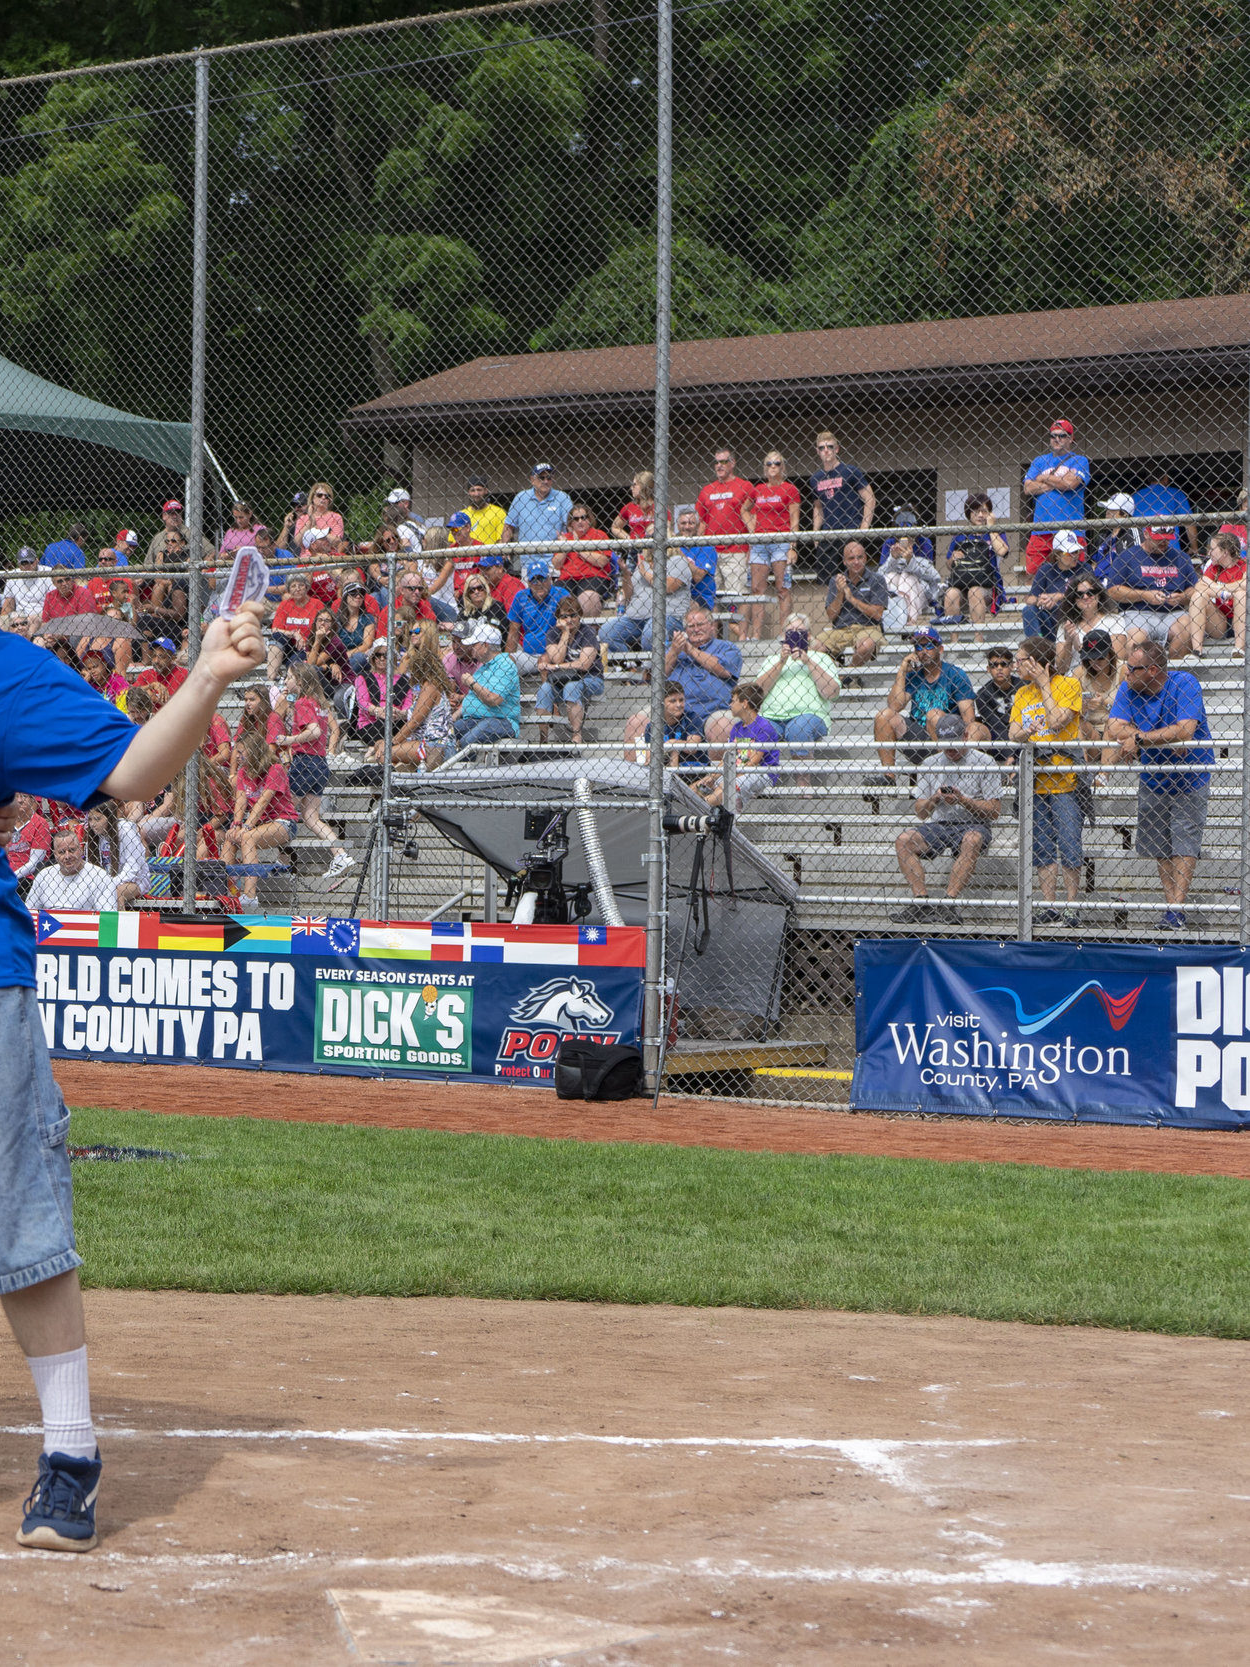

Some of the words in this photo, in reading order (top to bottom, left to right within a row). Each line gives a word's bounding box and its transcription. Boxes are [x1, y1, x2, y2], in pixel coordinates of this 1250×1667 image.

[108, 956, 238, 1008] COMES
[246, 961, 295, 1011] TO
[315, 968, 354, 981] EVERY
[356, 971, 406, 984] SEASON
[408, 973, 456, 986] STARTS
[457, 975, 475, 987] AT
[322, 985, 465, 1050] DICK'S
[936, 1012, 981, 1028] visit
[1176, 966, 1250, 1036] DI
[62, 1004, 205, 1058] COUNTY
[212, 1011, 263, 1061] PA
[323, 1044, 401, 1062] SPORTING
[494, 1063, 531, 1078] Protect
[533, 1065, 551, 1079] Our
[888, 1022, 1132, 1085] Washington
[920, 1068, 1003, 1092] County,
[1008, 1072, 1039, 1090] PA
